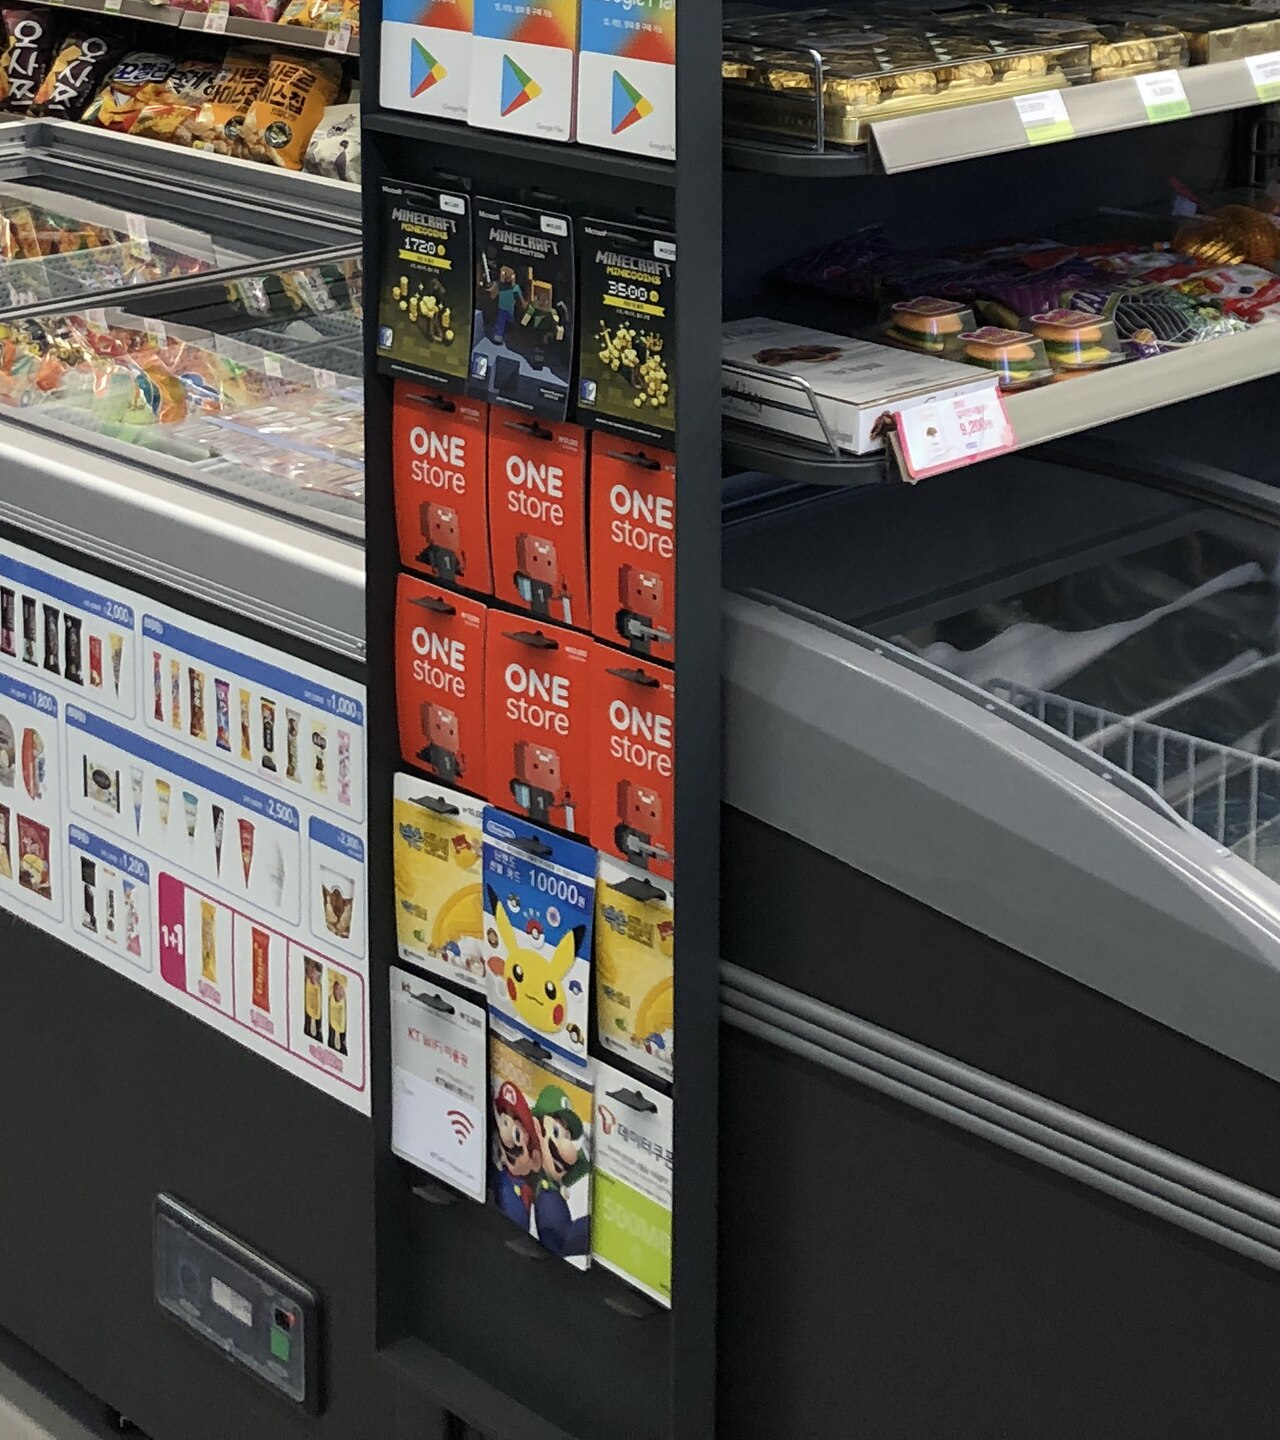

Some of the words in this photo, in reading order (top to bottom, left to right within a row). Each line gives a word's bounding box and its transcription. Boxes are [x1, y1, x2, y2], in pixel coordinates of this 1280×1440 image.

[391, 208, 457, 233] MINECRAFT
[404, 237, 436, 256] 1720
[489, 227, 559, 256] MINECRAFT
[595, 250, 671, 278] MINECRAFT
[606, 265, 662, 286] MINECOINS
[607, 280, 648, 301] 3500
[410, 427, 466, 467] ONE
[411, 460, 466, 494] store
[506, 455, 564, 499] ONE
[508, 490, 564, 526] store
[610, 484, 674, 530] ONE
[611, 520, 674, 558] store
[412, 626, 466, 671] ONE
[413, 659, 466, 698] store
[505, 663, 570, 708] ONE
[330, 693, 364, 722] 1,000
[506, 697, 570, 736] store
[609, 700, 672, 748] ONE
[611, 734, 672, 777] store
[268, 798, 300, 825] 2,500
[161, 923, 184, 956] 1+1
